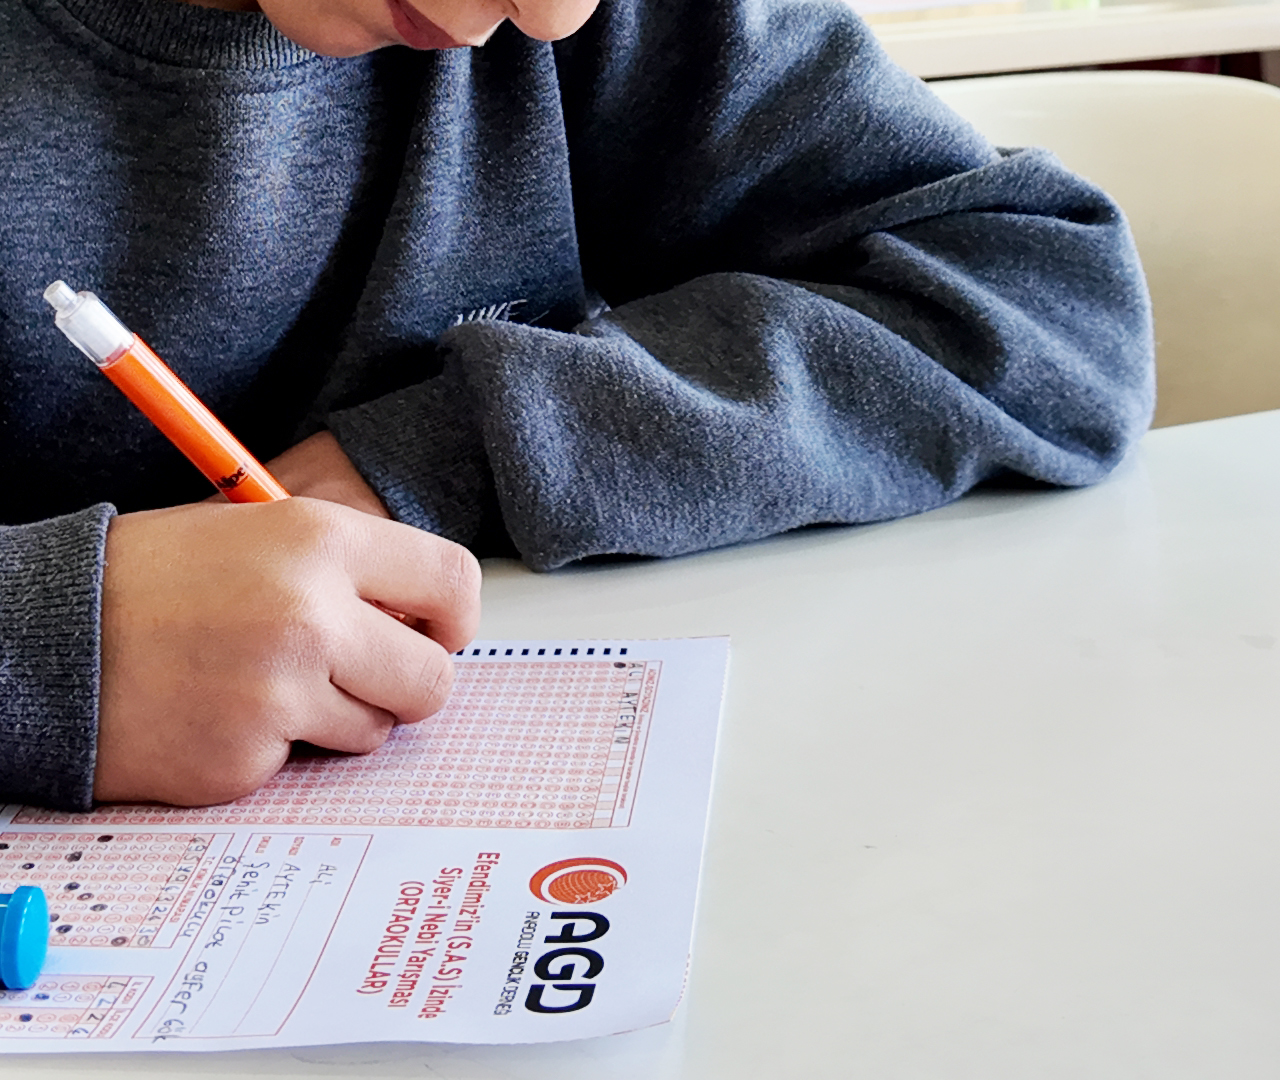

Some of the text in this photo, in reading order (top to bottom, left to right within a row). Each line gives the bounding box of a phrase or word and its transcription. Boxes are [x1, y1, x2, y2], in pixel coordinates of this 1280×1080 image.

[356, 880, 426, 995] (ORTAOKULLAR)
[387, 866, 463, 1008] Siyer-i Nebi Yarışması
[453, 851, 501, 933] Efendimiz'in
[524, 910, 611, 1014] AGD
